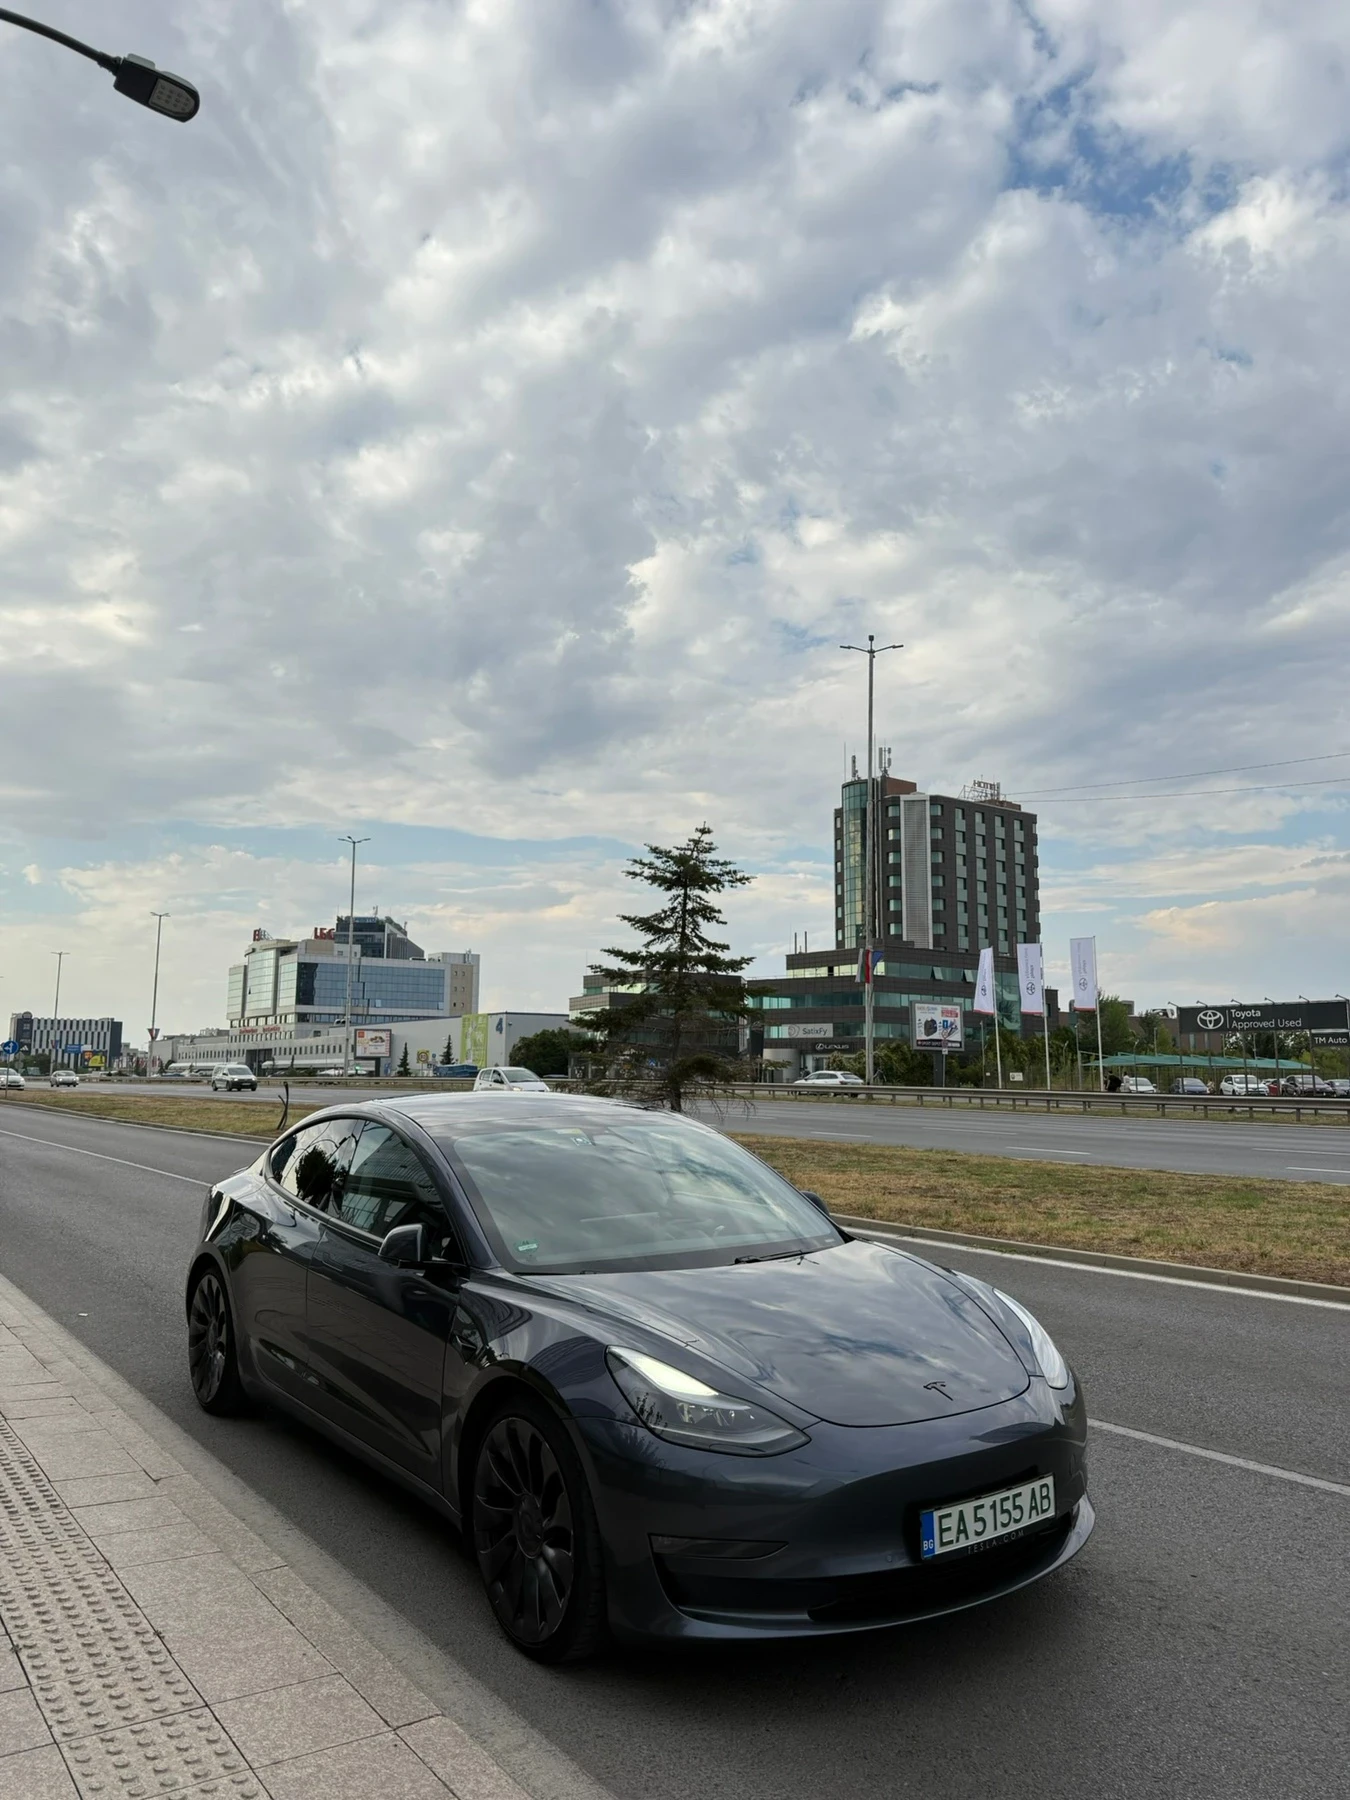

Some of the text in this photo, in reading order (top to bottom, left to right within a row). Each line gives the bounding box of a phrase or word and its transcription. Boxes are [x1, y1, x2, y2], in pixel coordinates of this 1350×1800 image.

[1230, 1009, 1261, 1019] Toyota
[496, 1017, 503, 1034] 4
[1231, 1018, 1302, 1030] Approved Used
[1314, 1036, 1348, 1044] TM Auto
[923, 1539, 934, 1551] BG
[967, 1529, 1026, 1555] TESLA.COM
